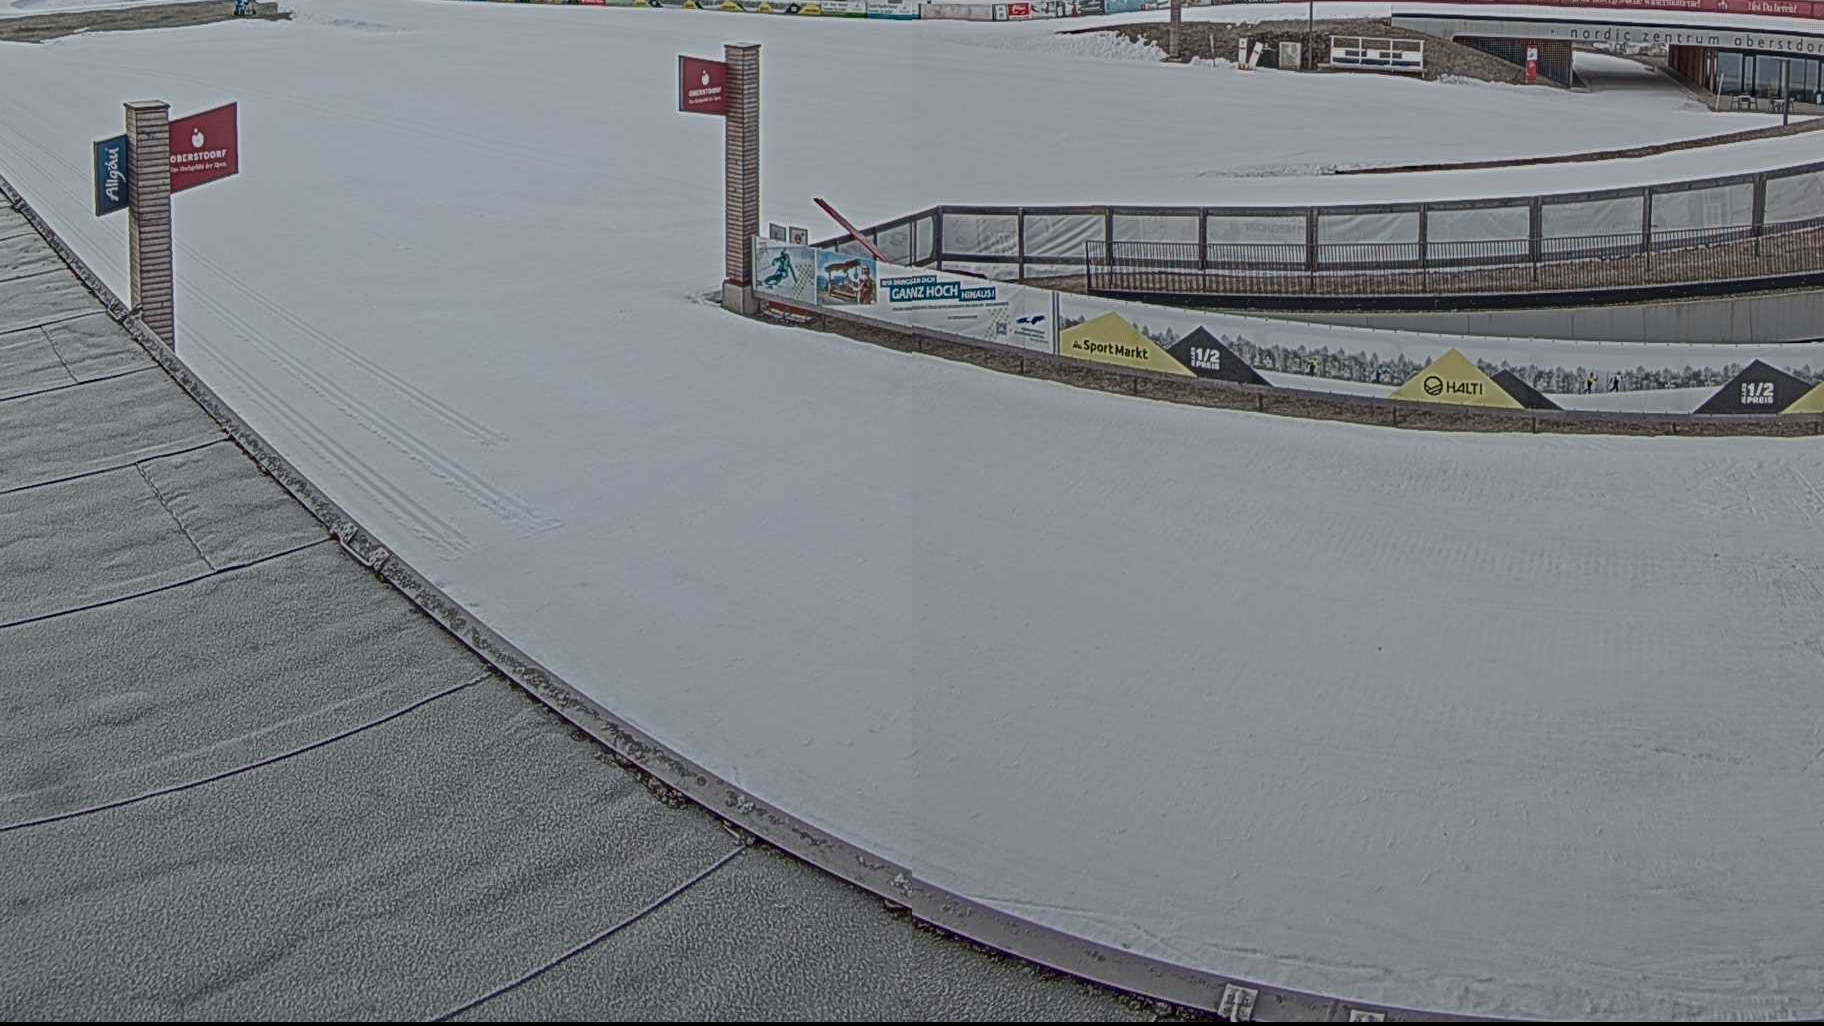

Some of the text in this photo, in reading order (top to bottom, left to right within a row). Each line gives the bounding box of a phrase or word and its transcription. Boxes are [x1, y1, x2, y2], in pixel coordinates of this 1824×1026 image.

[1570, 27, 1631, 41] nordic
[1643, 32, 1720, 45] zentrum
[170, 149, 227, 163] OBERSTDORF
[105, 147, 126, 202] Allgäu
[926, 285, 958, 298] HOCH
[1083, 339, 1149, 360] Sport Markt
[1196, 347, 1220, 362] 1/2
[1446, 380, 1483, 395] HALTI
[1747, 382, 1774, 397] 1/2
